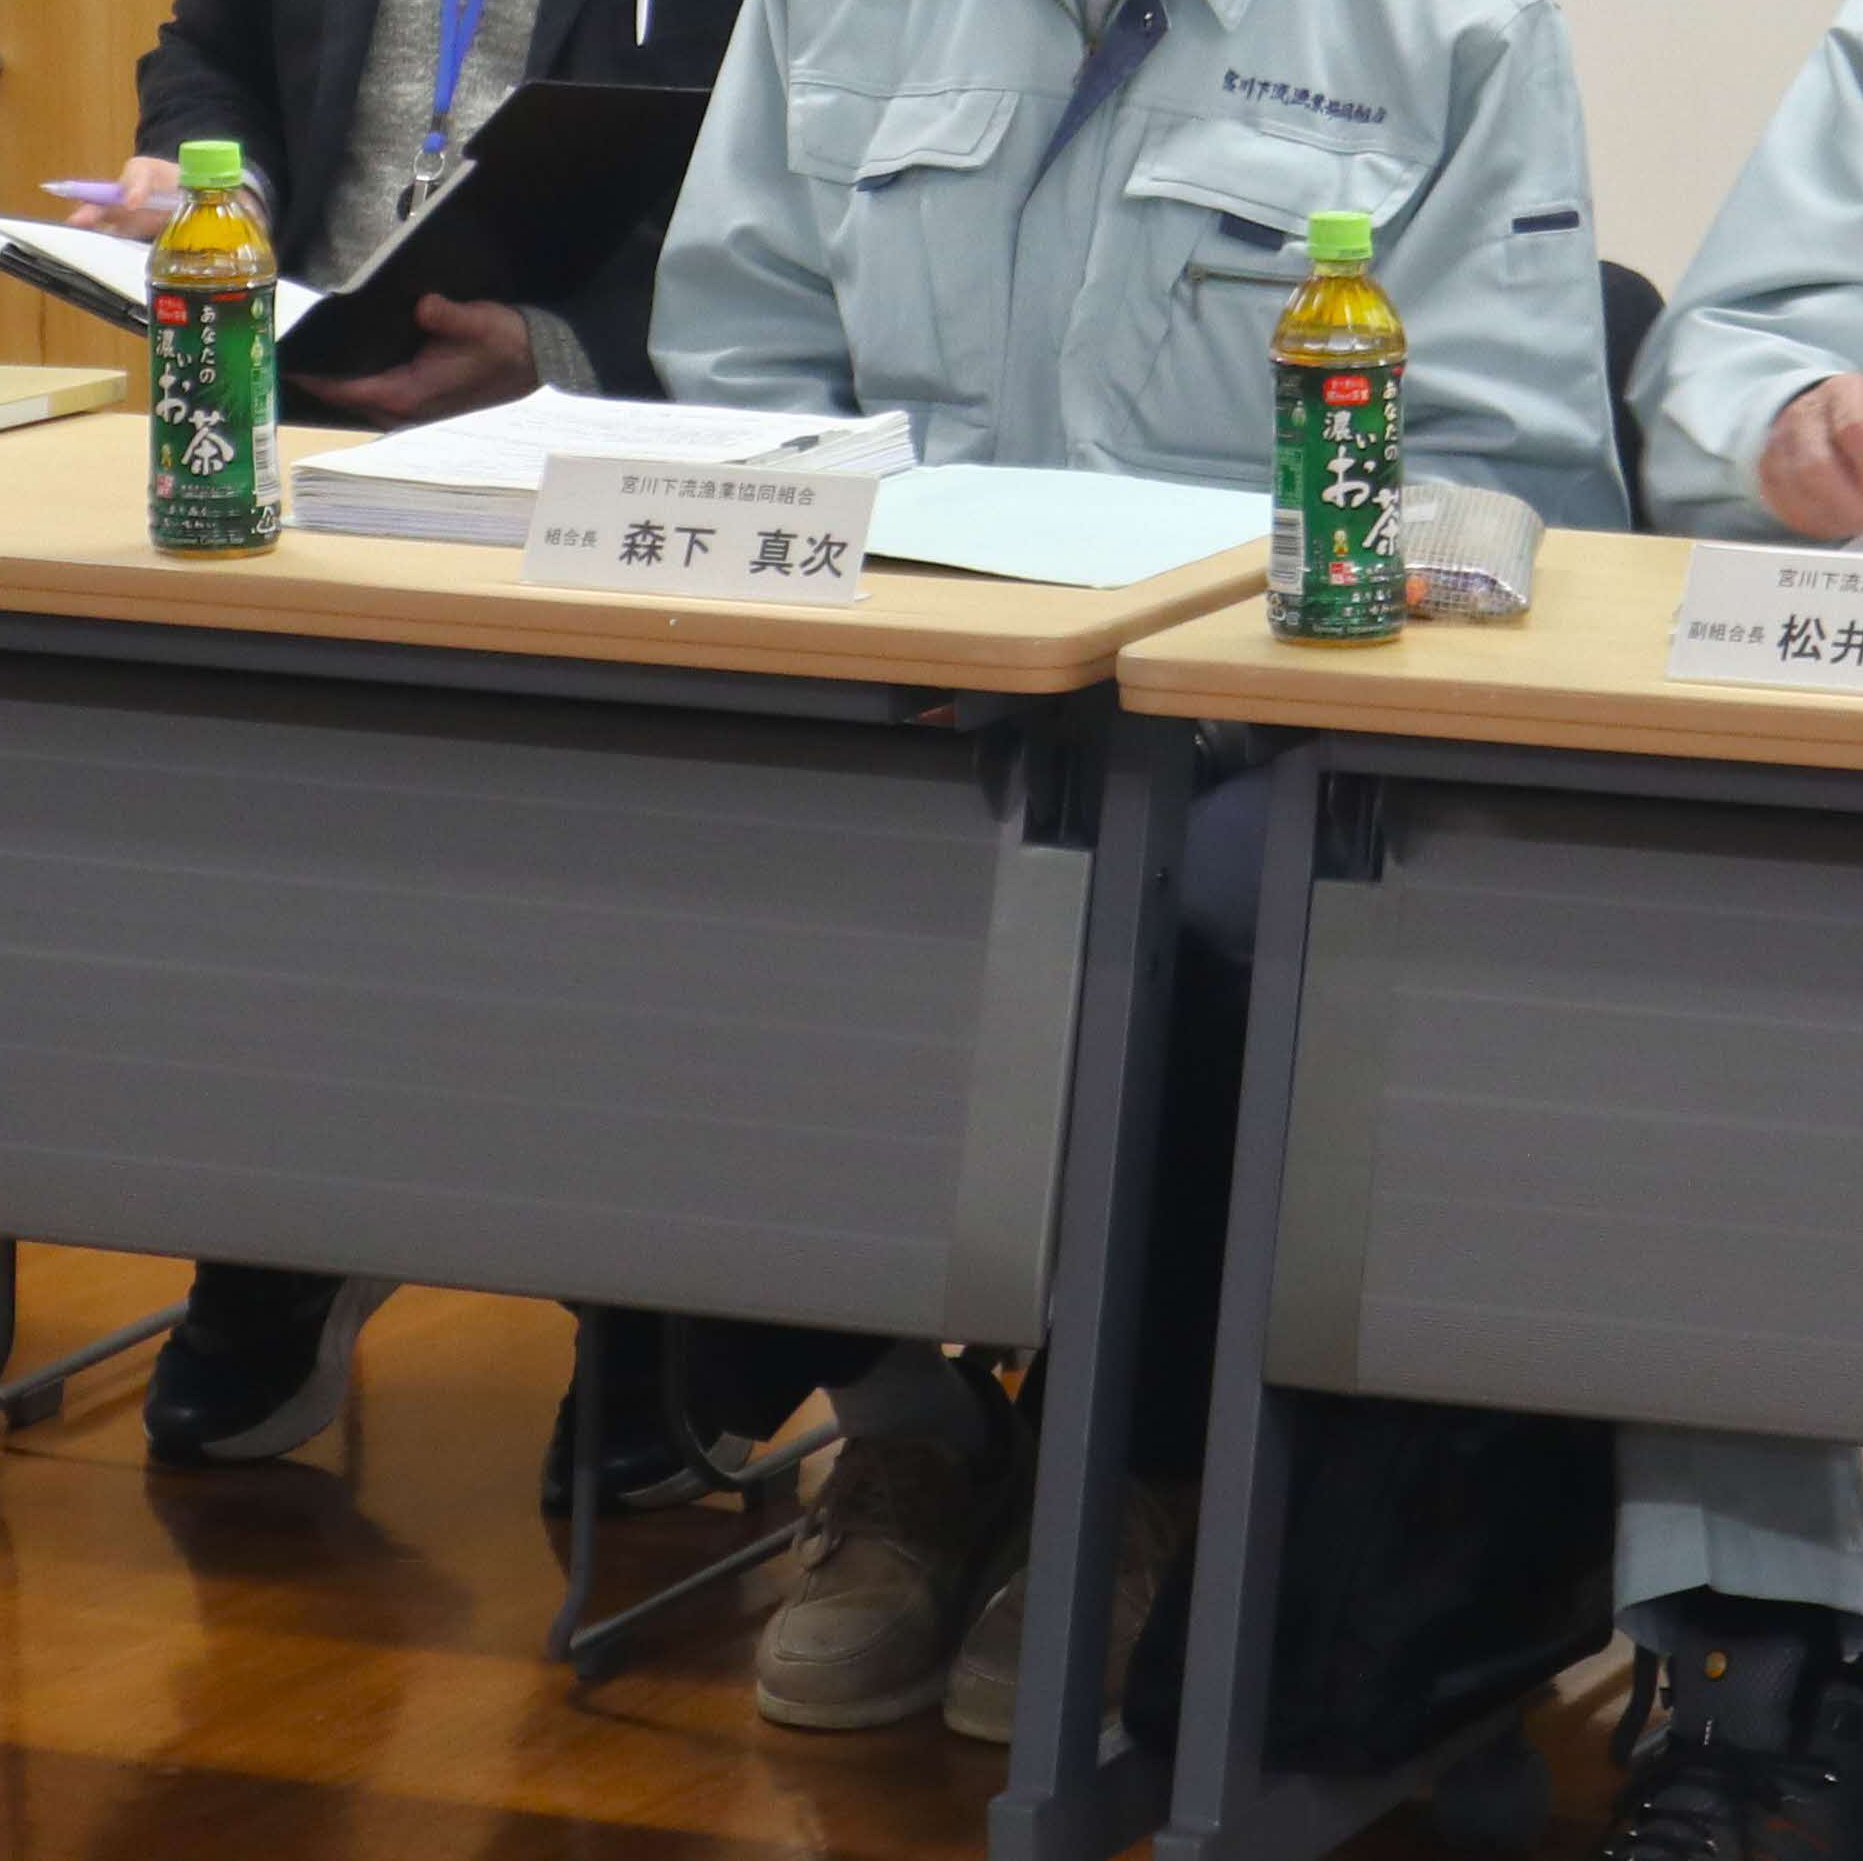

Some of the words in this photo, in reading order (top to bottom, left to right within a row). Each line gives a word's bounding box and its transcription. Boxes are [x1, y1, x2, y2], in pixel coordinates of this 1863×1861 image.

[199, 304, 216, 384] あなたの
[620, 474, 817, 506] 宮川下流漁業協同組合
[544, 526, 598, 549] 組合長
[618, 519, 716, 568] 森下
[749, 529, 848, 579] 真次
[1687, 620, 1766, 645] 副組合長
